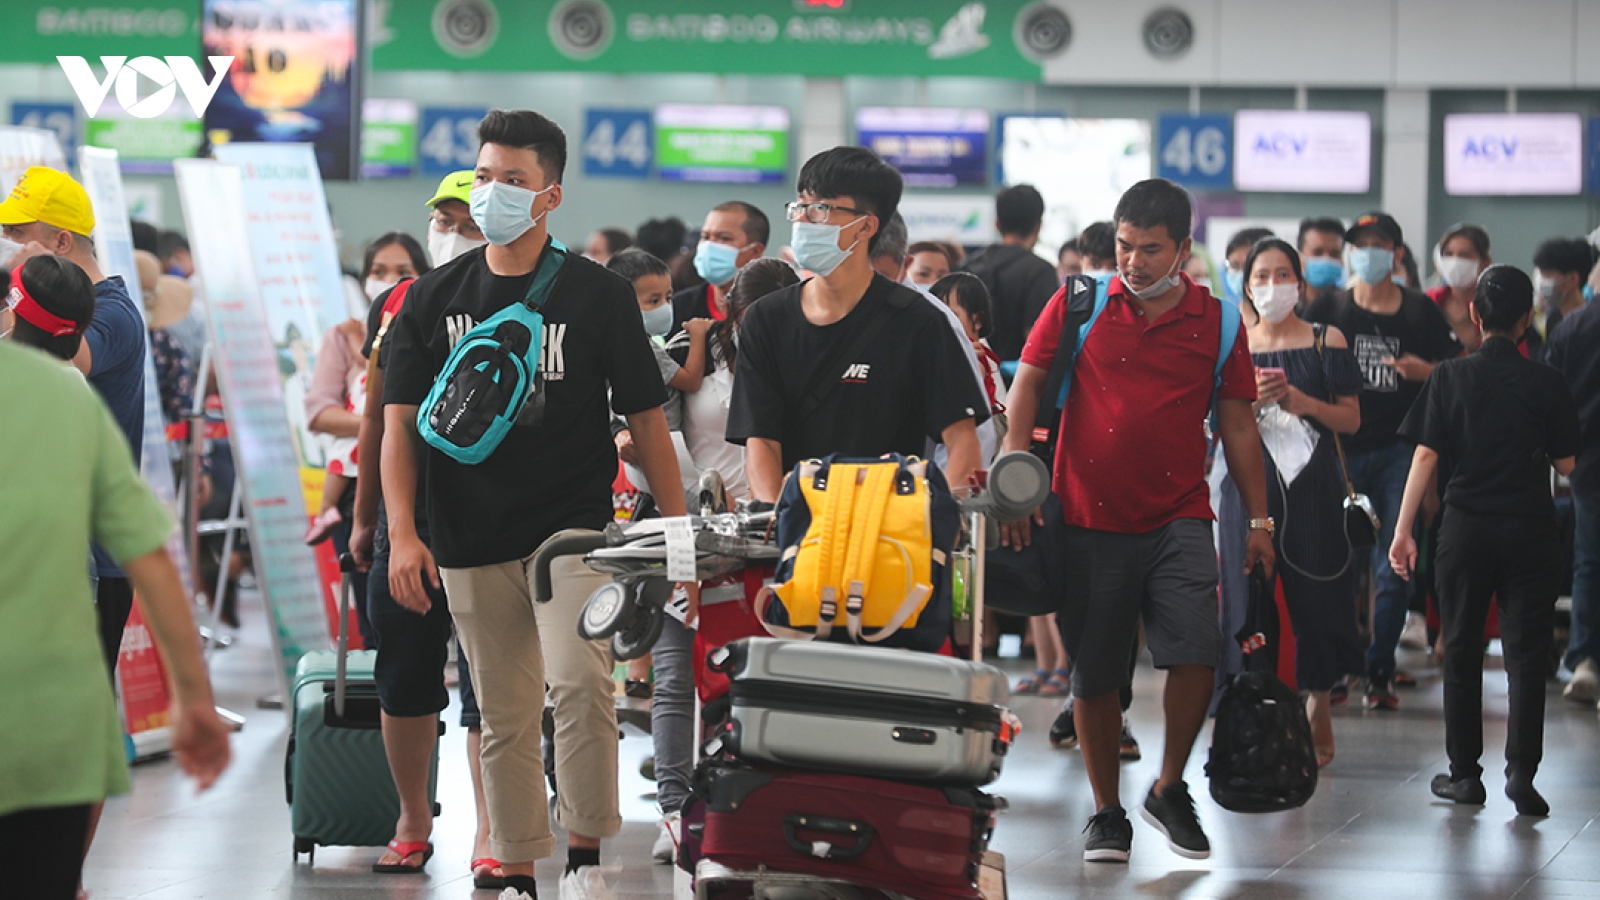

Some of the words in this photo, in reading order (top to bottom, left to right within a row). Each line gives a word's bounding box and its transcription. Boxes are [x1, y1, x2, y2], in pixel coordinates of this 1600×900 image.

[625, 13, 779, 43] BAMBOO
[784, 15, 935, 45] AIRWAYS
[420, 117, 483, 168] 43
[583, 118, 650, 168] 44
[1162, 126, 1227, 176] 46
[1253, 131, 1310, 160] ACV
[1461, 134, 1521, 164] ACV
